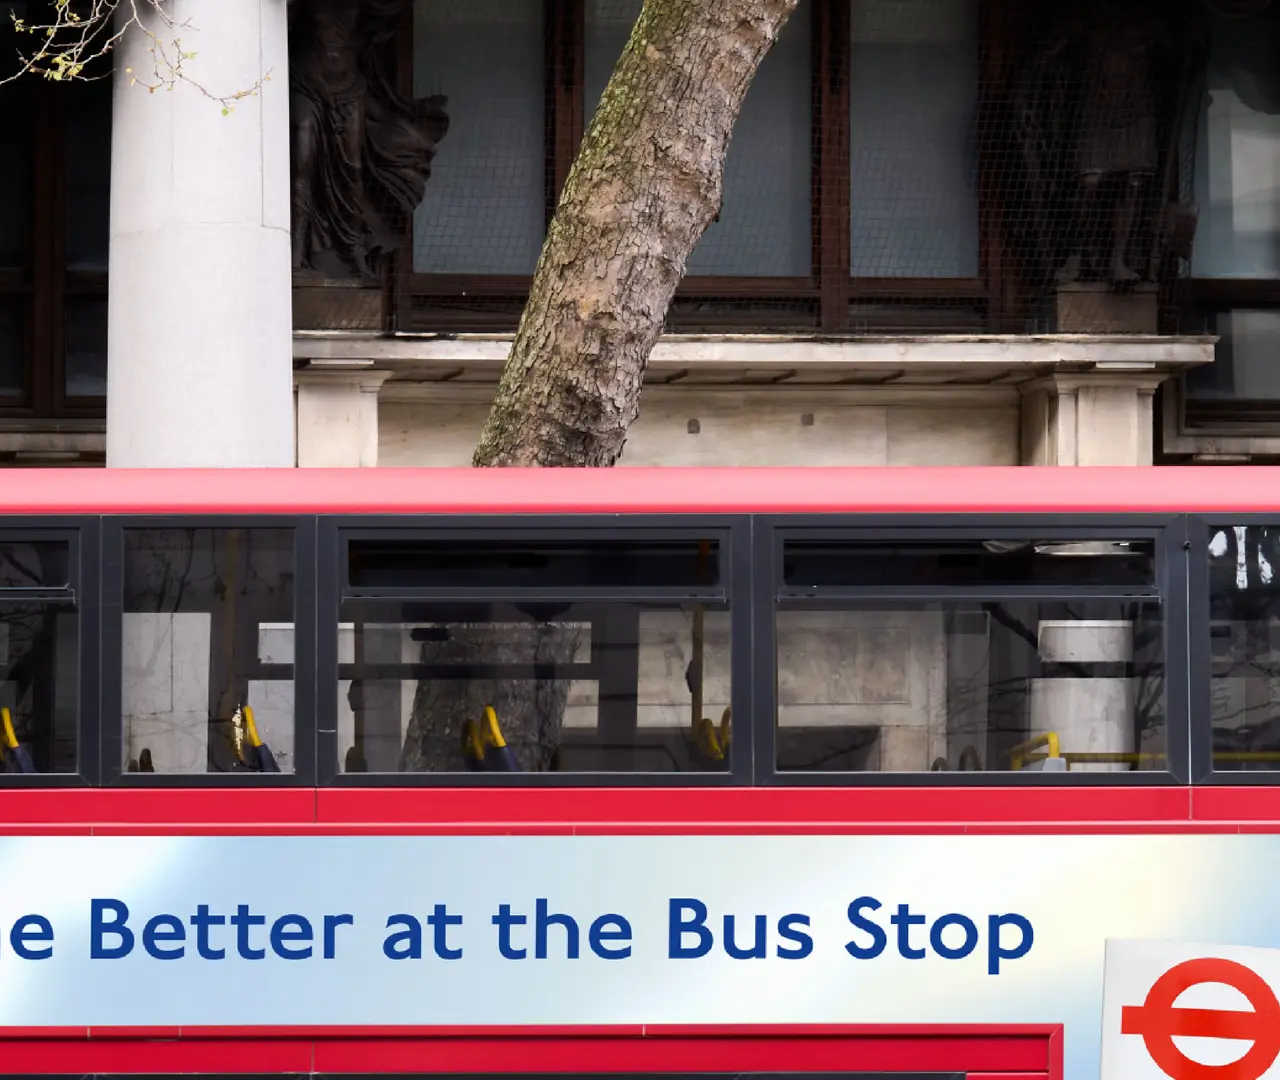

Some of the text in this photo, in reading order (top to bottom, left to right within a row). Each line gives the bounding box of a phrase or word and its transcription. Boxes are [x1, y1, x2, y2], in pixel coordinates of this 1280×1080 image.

[90, 898, 354, 961] Better
[382, 904, 463, 960] at
[491, 898, 633, 960] the
[668, 898, 814, 960] Bus
[844, 896, 1034, 975] Stop
